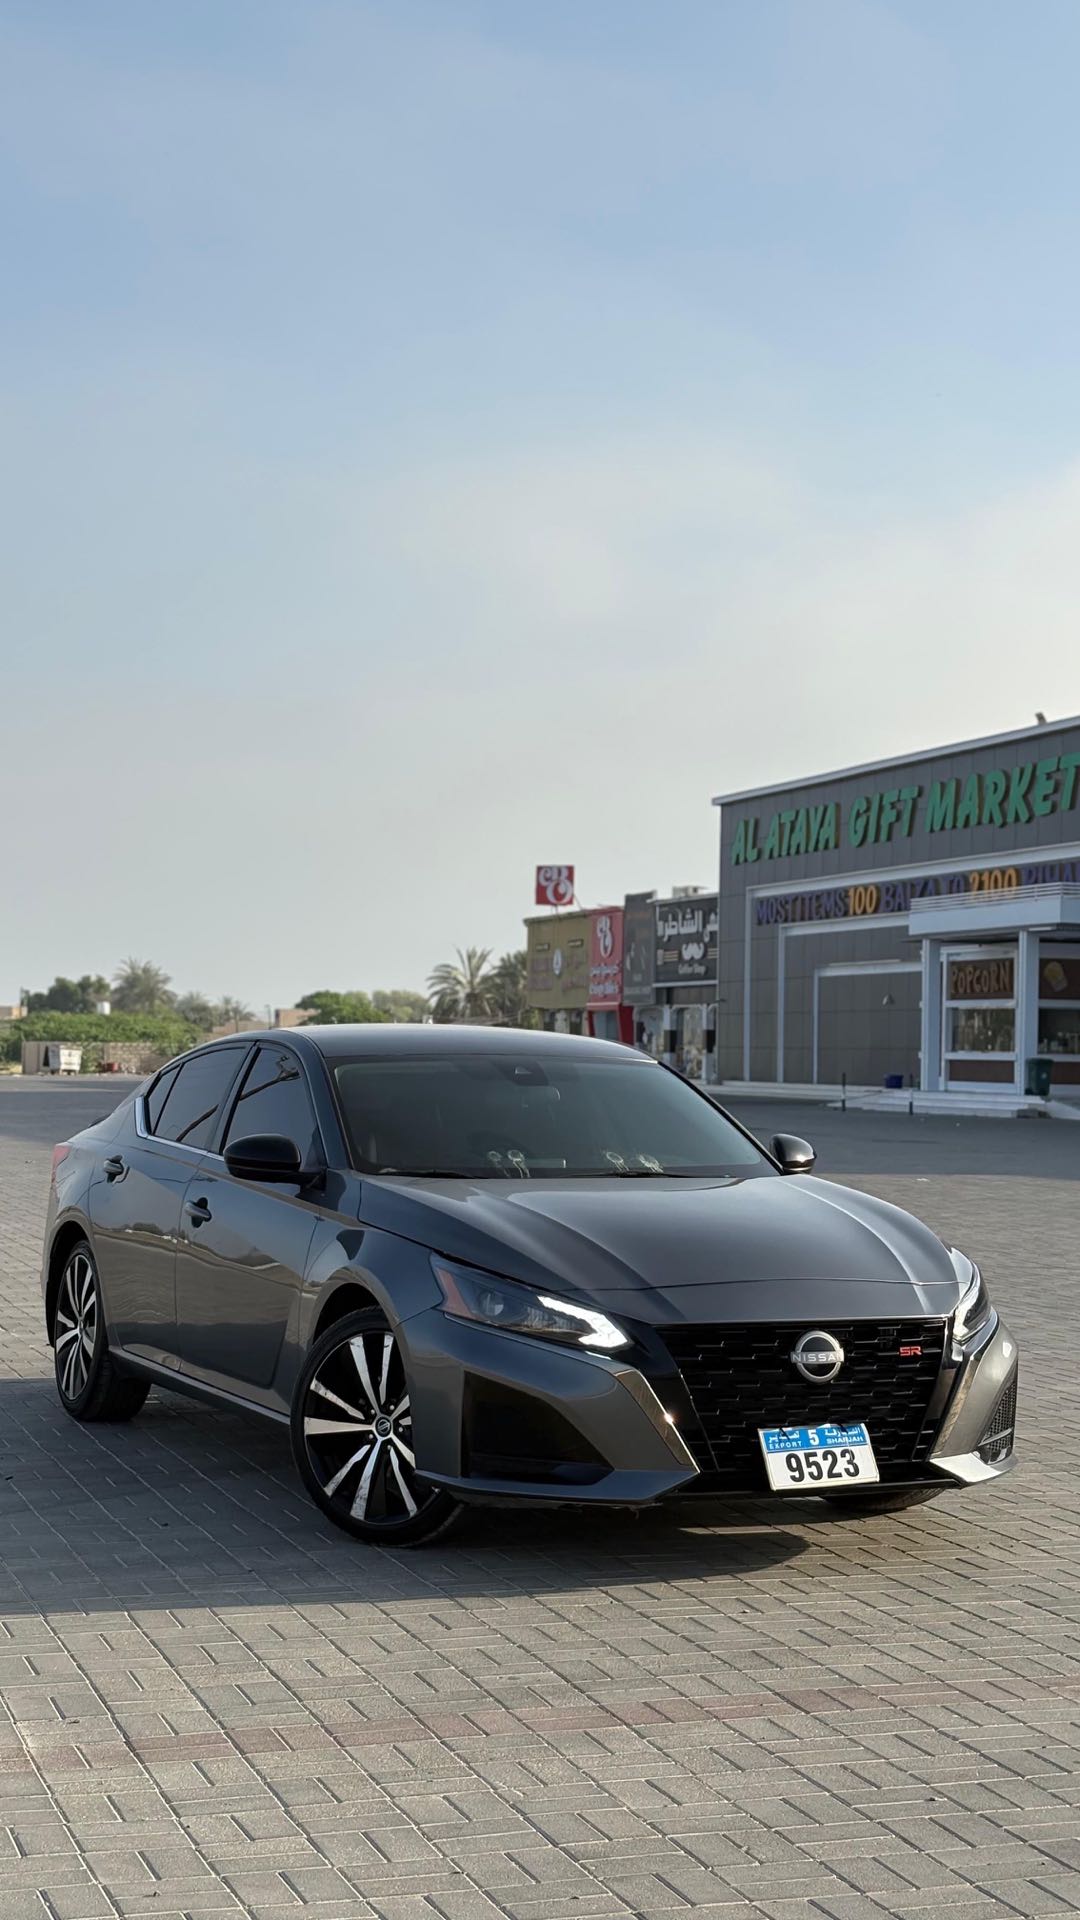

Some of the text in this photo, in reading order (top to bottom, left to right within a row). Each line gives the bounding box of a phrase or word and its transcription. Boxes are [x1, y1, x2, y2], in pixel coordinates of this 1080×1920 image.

[732, 752, 1080, 866] AL ATAYA GIFT MARKET
[756, 895, 794, 925] MOST
[795, 887, 846, 921] ITEMS
[848, 884, 879, 916] 100
[952, 961, 1011, 993] POPCORN
[792, 1352, 841, 1362] NISSAN
[899, 1346, 922, 1356] SR
[769, 1440, 802, 1450] EXPORT
[808, 1429, 820, 1446] 5
[826, 1435, 864, 1445] SHARJAH
[785, 1448, 860, 1483] 9523
